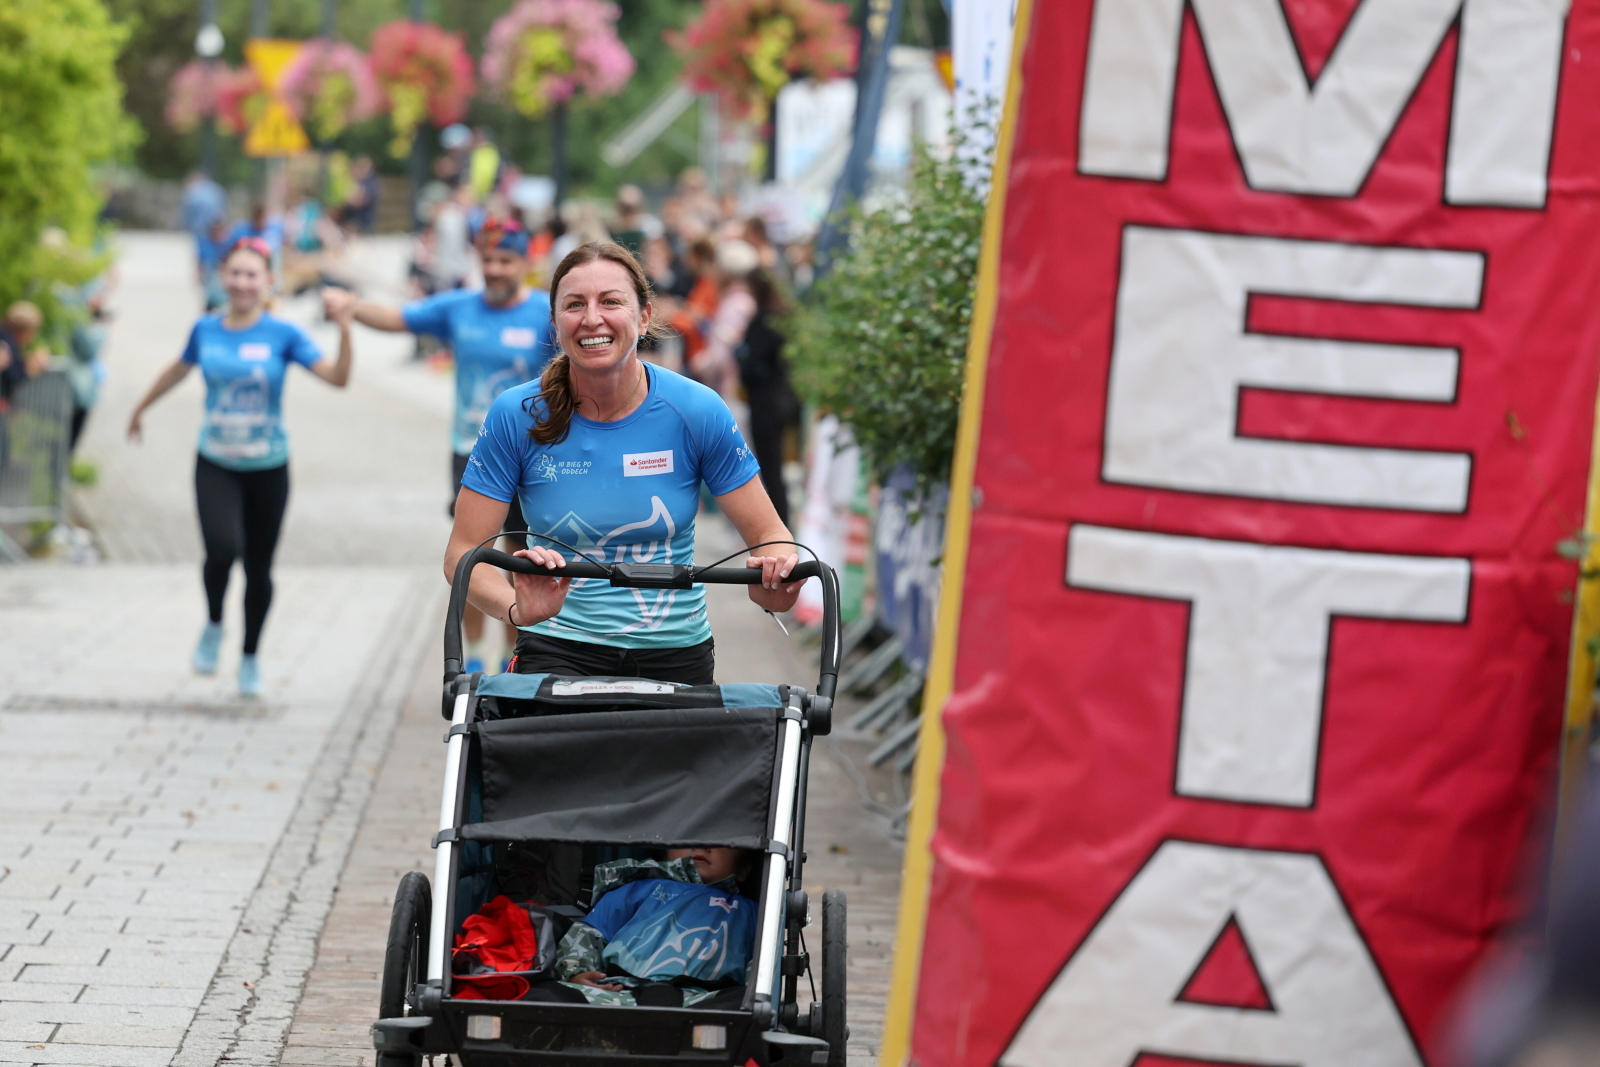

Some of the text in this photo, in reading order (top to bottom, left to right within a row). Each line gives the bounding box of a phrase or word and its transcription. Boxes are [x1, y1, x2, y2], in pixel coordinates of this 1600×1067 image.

[583, 460, 592, 468] PO
[638, 457, 668, 466] Santander
[992, 0, 1568, 1067] META
